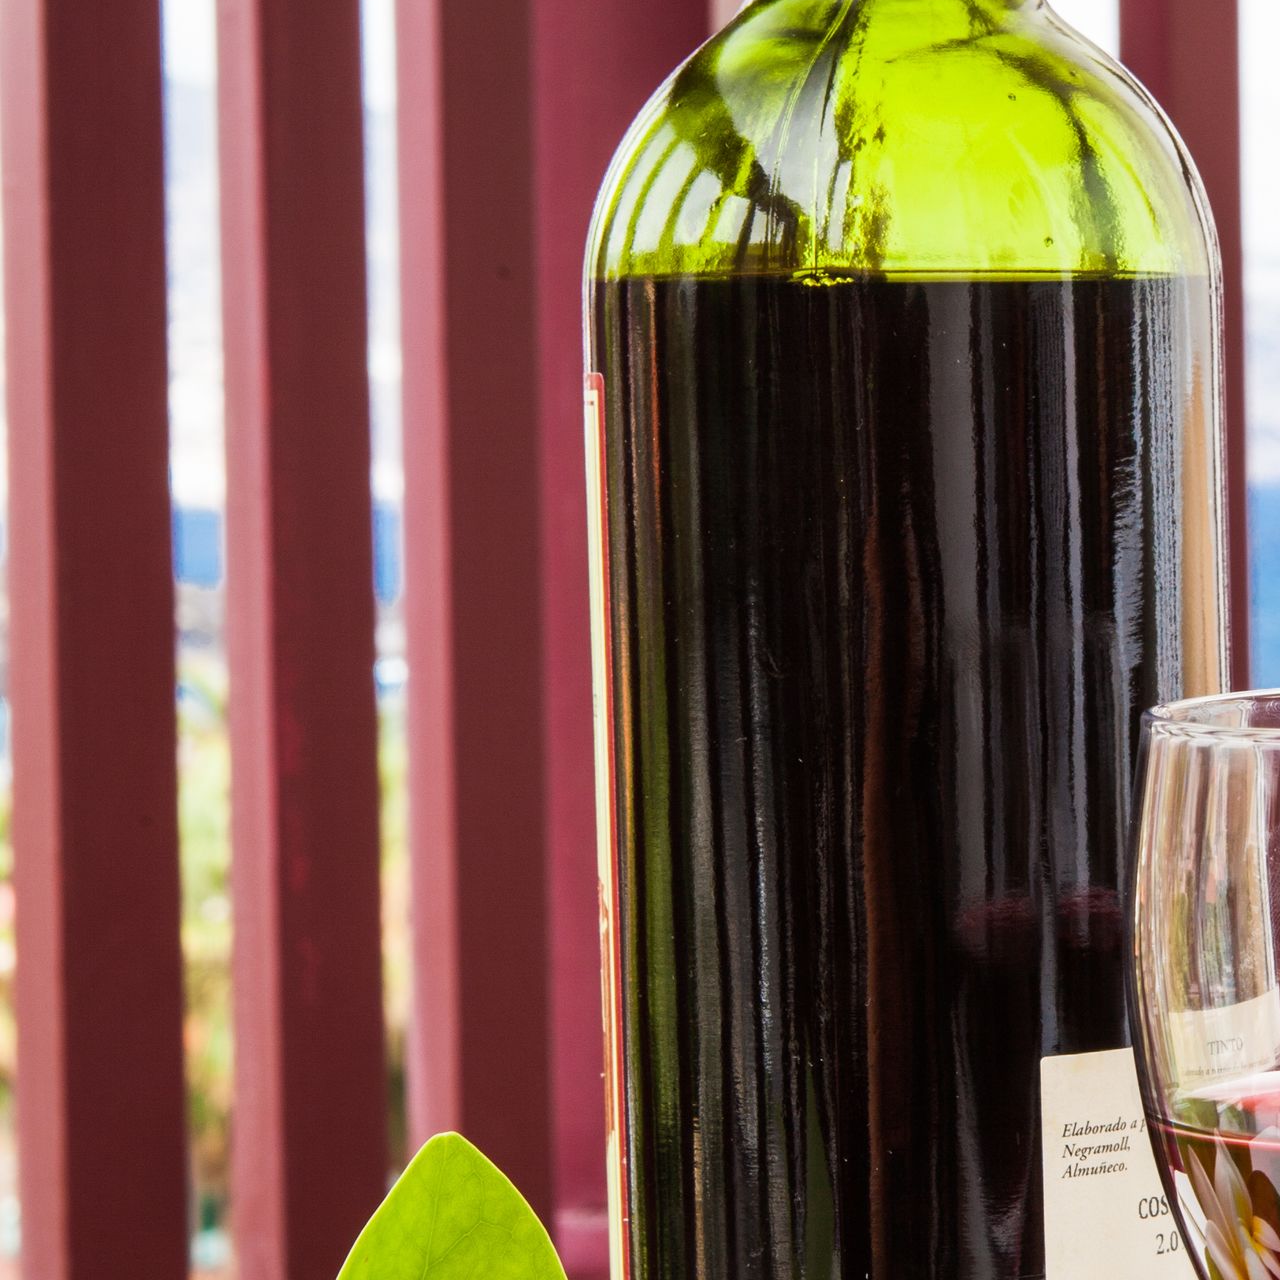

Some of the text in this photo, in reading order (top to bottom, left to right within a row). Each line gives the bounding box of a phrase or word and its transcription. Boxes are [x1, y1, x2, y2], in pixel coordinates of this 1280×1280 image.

[1207, 1037, 1244, 1057] TINTO
[1061, 1116, 1127, 1138] Elaborado
[1130, 1119, 1138, 1130] a
[1061, 1135, 1131, 1161] Negramoll,
[1061, 1161, 1128, 1179] Almuñeco.
